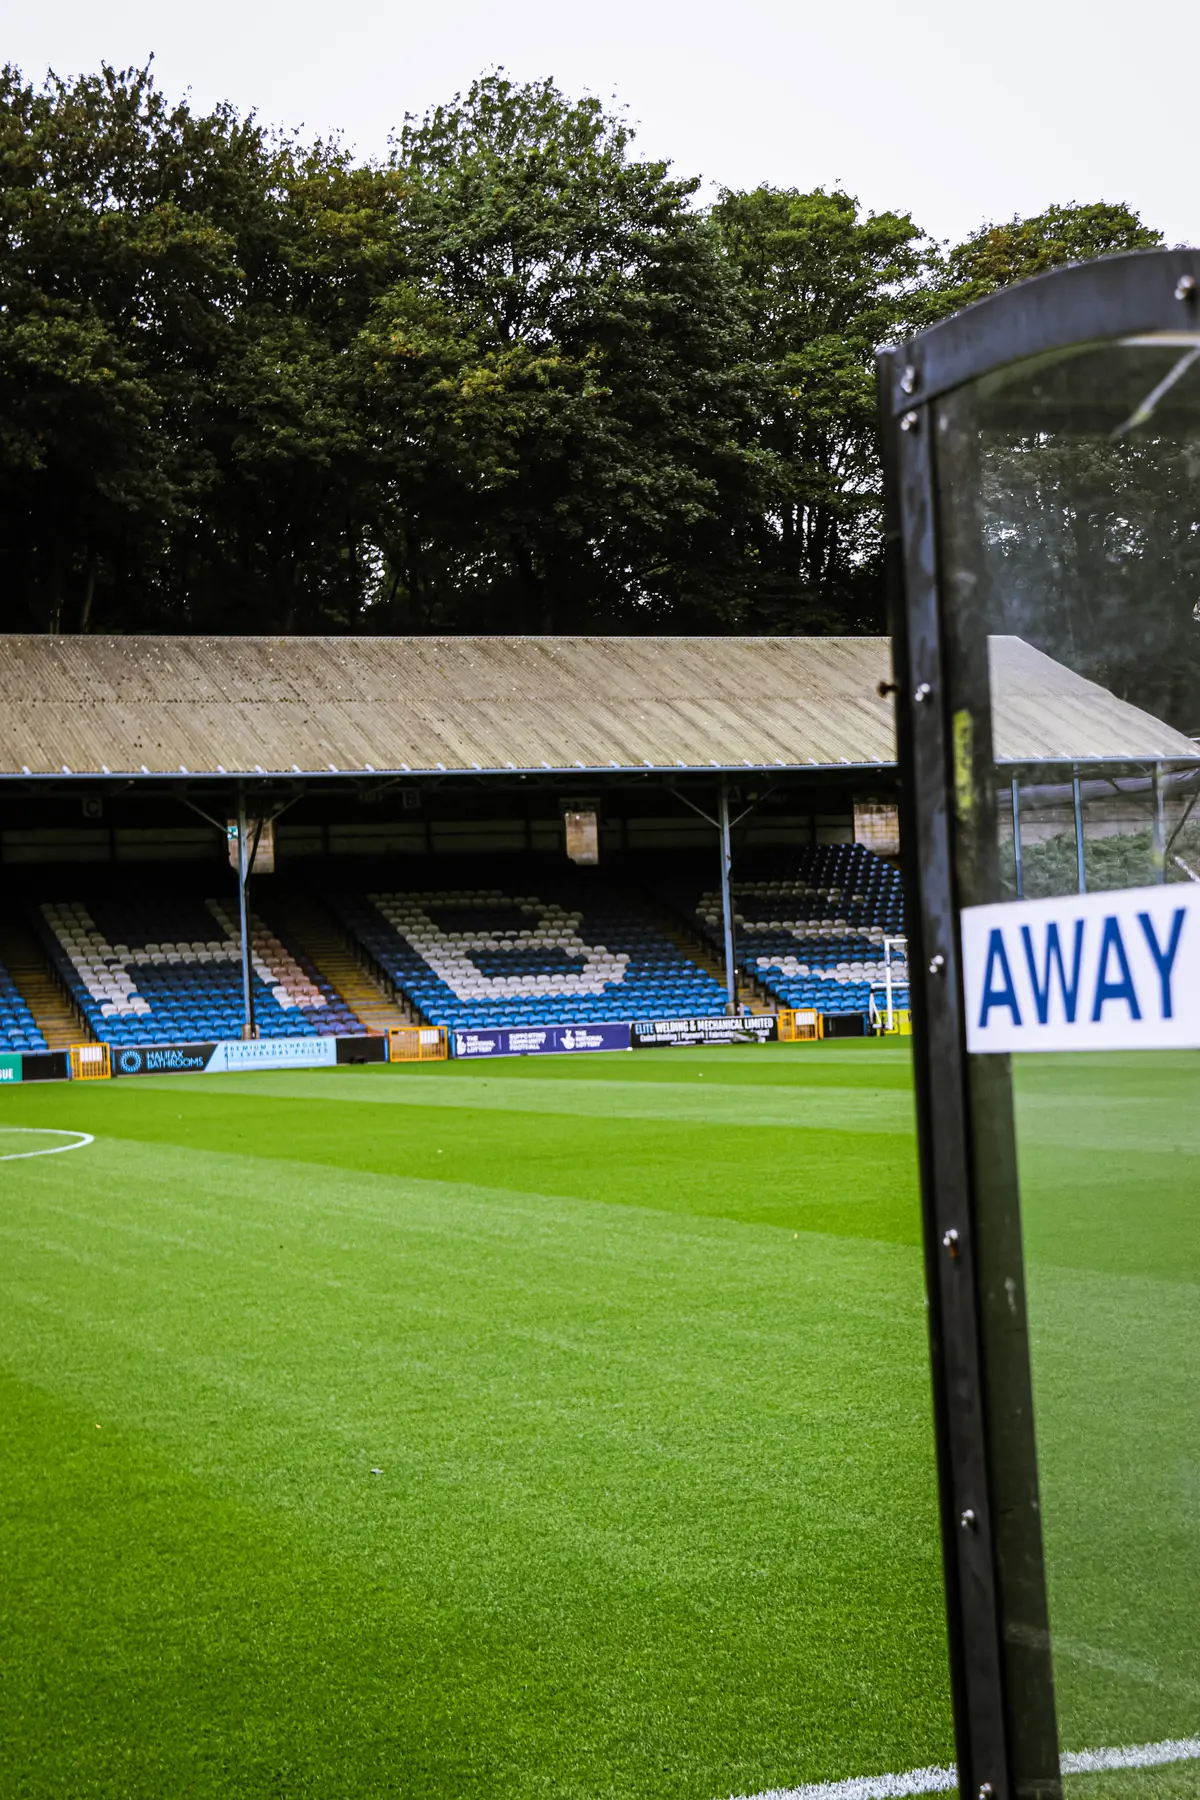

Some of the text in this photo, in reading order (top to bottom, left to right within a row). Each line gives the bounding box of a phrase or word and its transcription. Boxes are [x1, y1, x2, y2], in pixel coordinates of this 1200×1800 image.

[978, 908, 1187, 1027] AWAY
[635, 1017, 774, 1035] ELITE WELDING & MECHANICAL LIMITED
[466, 1045, 493, 1054] LOTTERY
[575, 1040, 601, 1048] LOTTERY
[146, 1050, 184, 1061] HALIFAX
[146, 1057, 204, 1070] BATHROOMS
